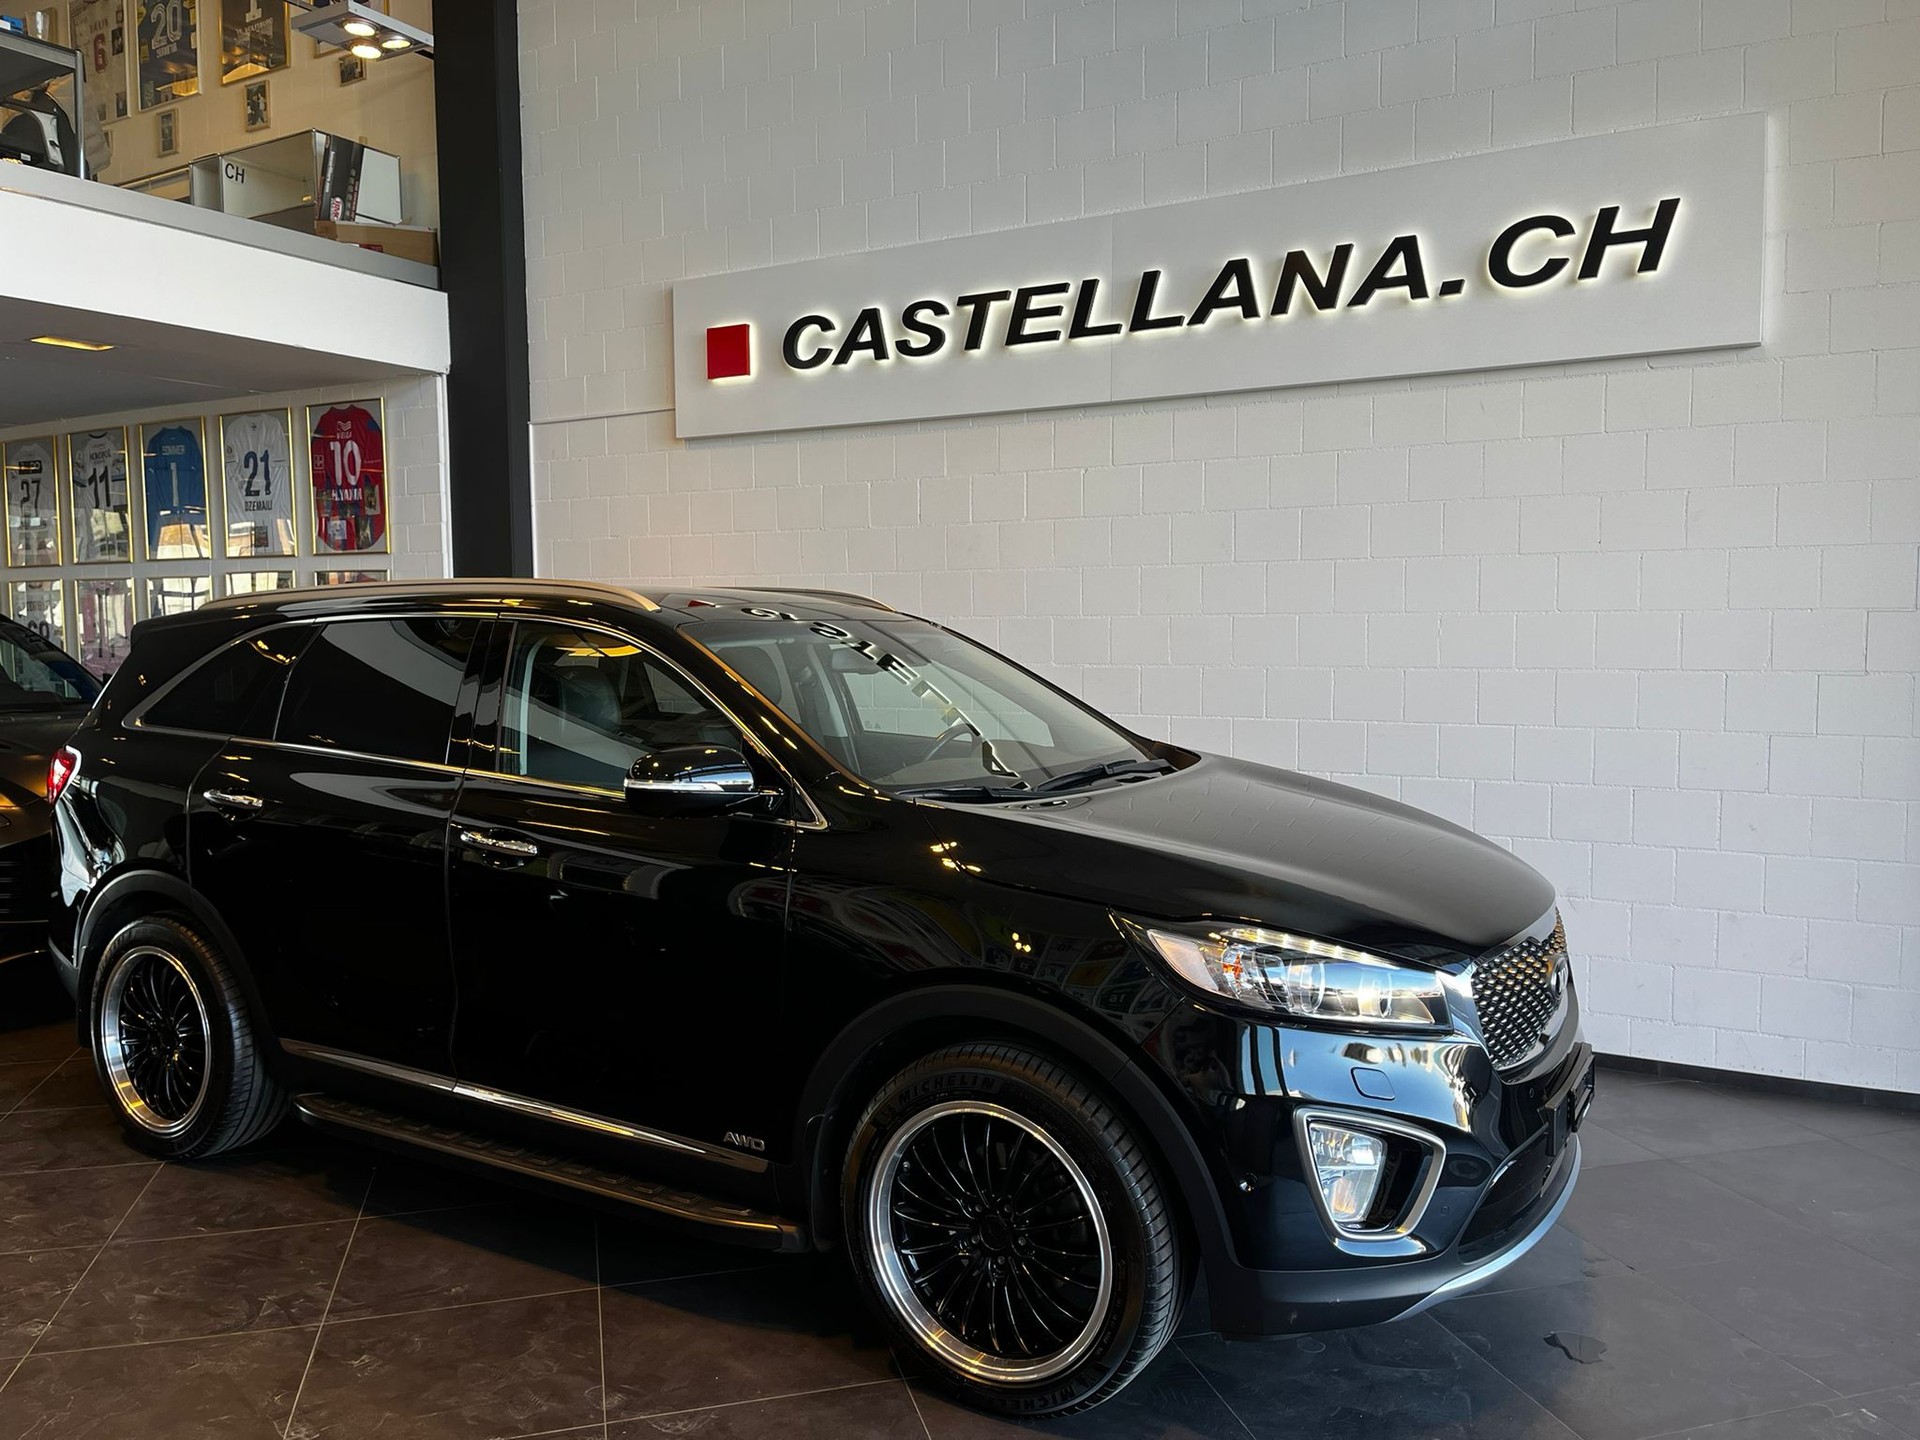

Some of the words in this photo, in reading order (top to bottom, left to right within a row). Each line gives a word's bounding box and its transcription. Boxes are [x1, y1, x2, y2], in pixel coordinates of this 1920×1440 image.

[150, 0, 183, 50] 20
[93, 33, 107, 75] 6
[225, 162, 245, 184] CH
[781, 196, 1681, 371] CASTELLANA.CH
[170, 461, 179, 507] 1
[243, 449, 272, 497] 21
[329, 439, 362, 486] 10
[20, 478, 42, 517] 27
[87, 465, 111, 509] 11
[897, 1074, 995, 1106] MICHELIN
[722, 1131, 766, 1152] AWD
